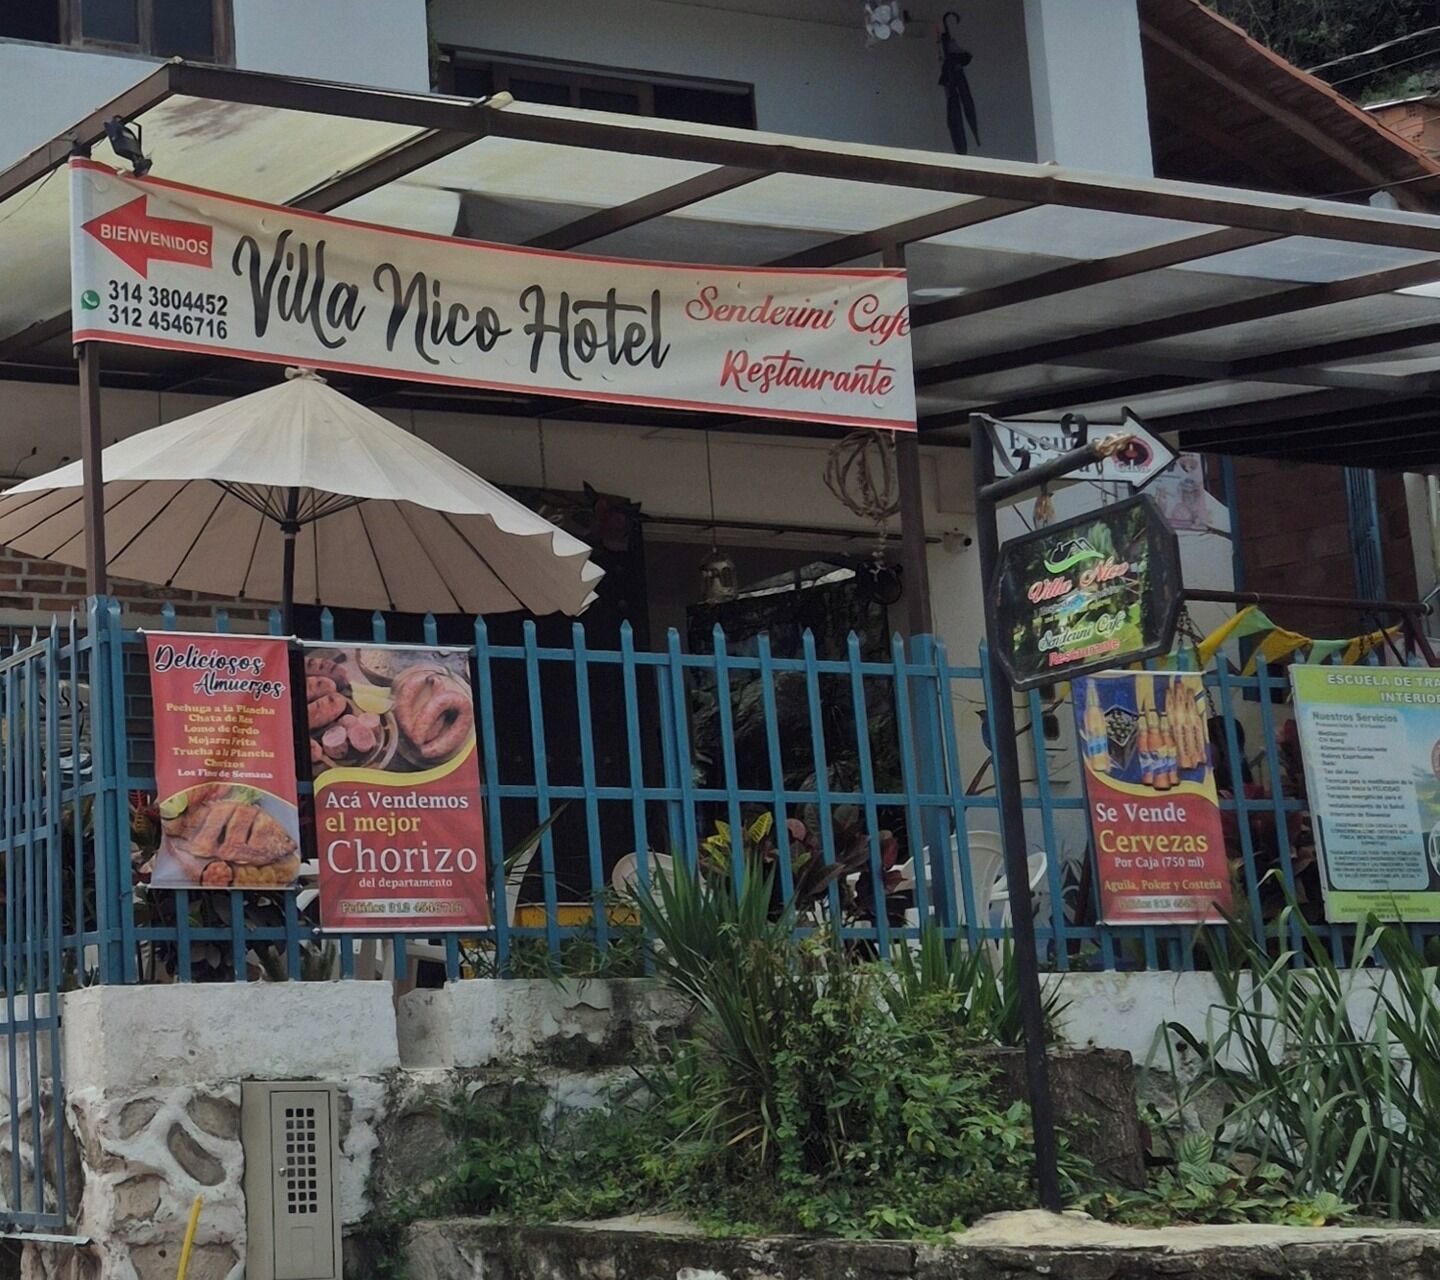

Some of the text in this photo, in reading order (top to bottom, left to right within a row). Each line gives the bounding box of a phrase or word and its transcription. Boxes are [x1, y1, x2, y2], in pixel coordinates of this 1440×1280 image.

[100, 224, 208, 255] BIENVENIDOS
[109, 280, 228, 316] 314 3804452
[232, 229, 671, 382] Villa Nico Hotel
[108, 304, 228, 340] 312 4546716
[720, 349, 896, 395] Restaurante
[155, 644, 265, 675] Deliciosos
[193, 672, 286, 700] Almuerzos
[1327, 674, 1390, 686] ESCUELA
[1394, 676, 1412, 687] DE
[166, 703, 212, 714] Pechuga
[1312, 711, 1399, 723] Nuestros Servicios
[172, 747, 213, 756] Trucha
[230, 749, 275, 758] Plancha
[325, 791, 469, 809] Acá Vendemos
[1096, 802, 1187, 822] Se Vende
[325, 812, 421, 836] el mejor
[1100, 829, 1209, 853] Cervezas
[327, 839, 478, 874] Chorizo
[1114, 856, 1205, 869] Por Caja (750 ml)
[359, 878, 453, 890] del departamento
[1142, 879, 1171, 890] Poker
[1173, 881, 1181, 891] y
